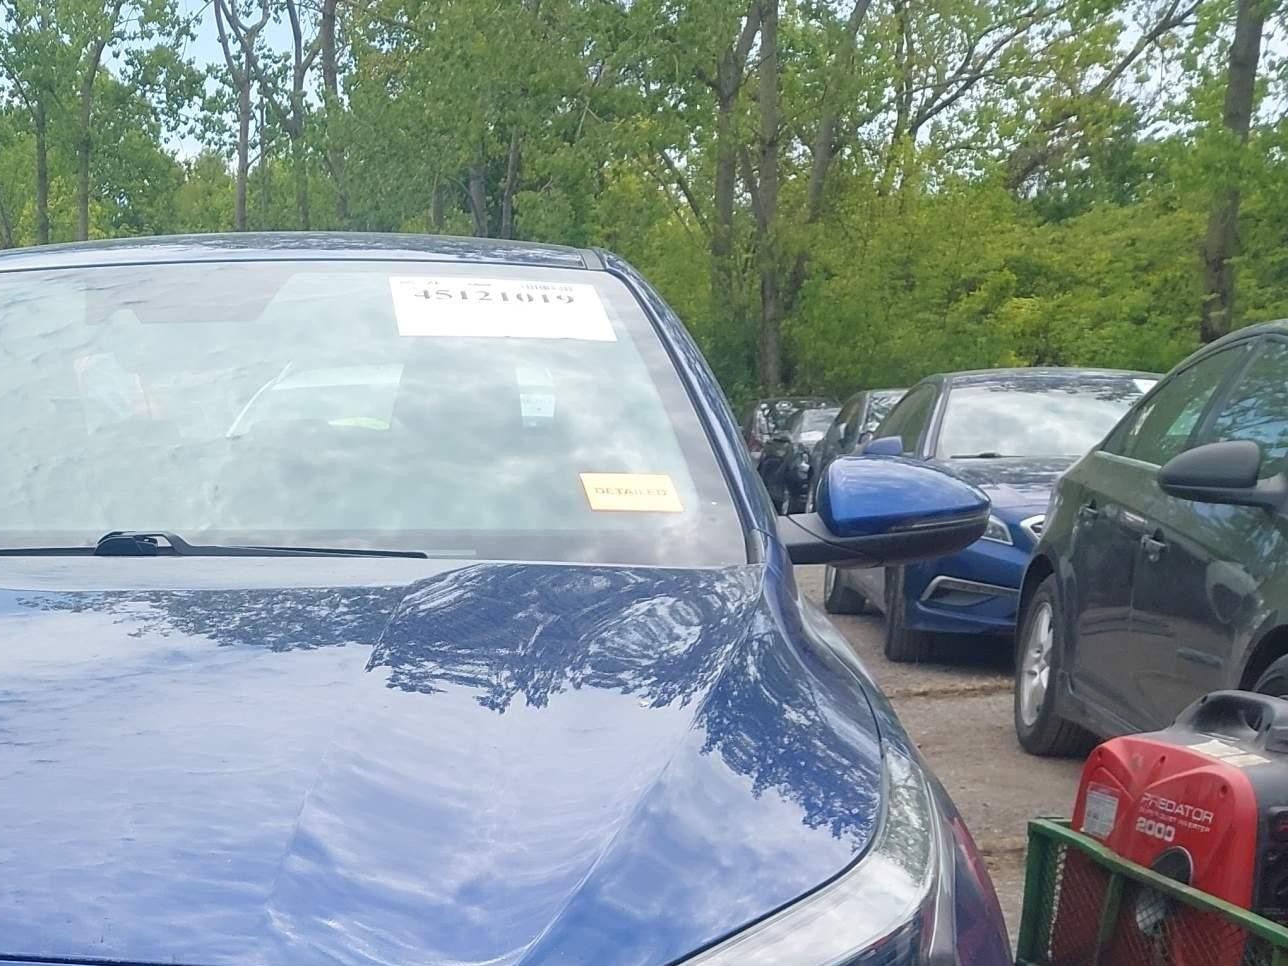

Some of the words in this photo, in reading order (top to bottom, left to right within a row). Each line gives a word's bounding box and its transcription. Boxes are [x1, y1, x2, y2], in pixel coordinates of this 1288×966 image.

[413, 289, 575, 304] 45121019
[594, 487, 669, 497] DETAILED
[1139, 792, 1215, 824] PREDATOR
[1135, 816, 1176, 842] 2000
